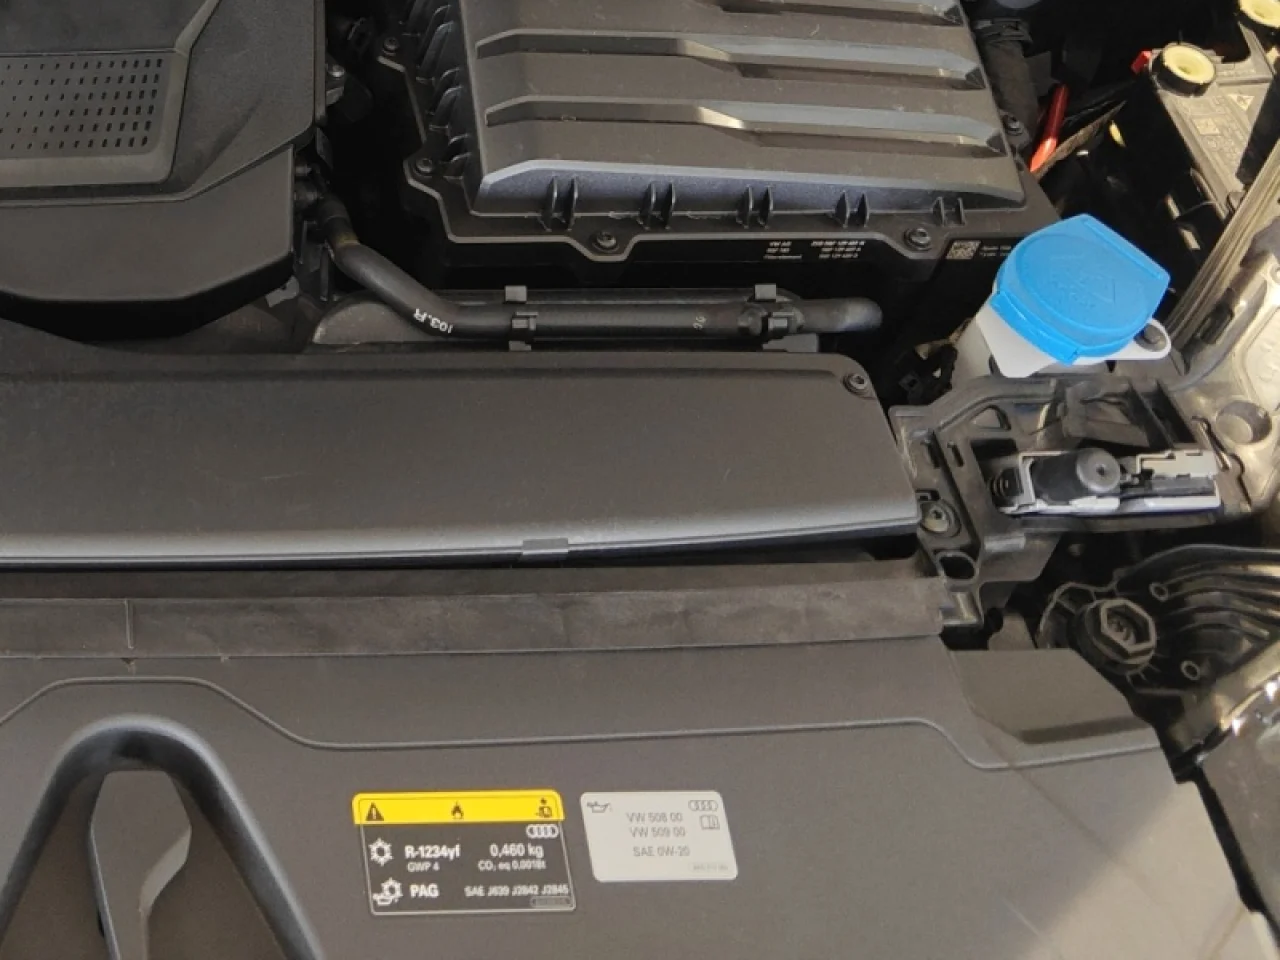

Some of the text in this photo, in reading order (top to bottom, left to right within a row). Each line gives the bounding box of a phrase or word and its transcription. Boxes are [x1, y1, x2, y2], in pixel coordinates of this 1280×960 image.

[625, 812, 684, 823] VW 508 00
[628, 826, 686, 838] VW 509 00
[404, 843, 461, 861] R-1234yf
[528, 843, 544, 859] kg
[633, 845, 691, 857] SAE 0W-20
[407, 861, 431, 872] GWP
[410, 883, 440, 898] PAG
[464, 885, 485, 897] SAE
